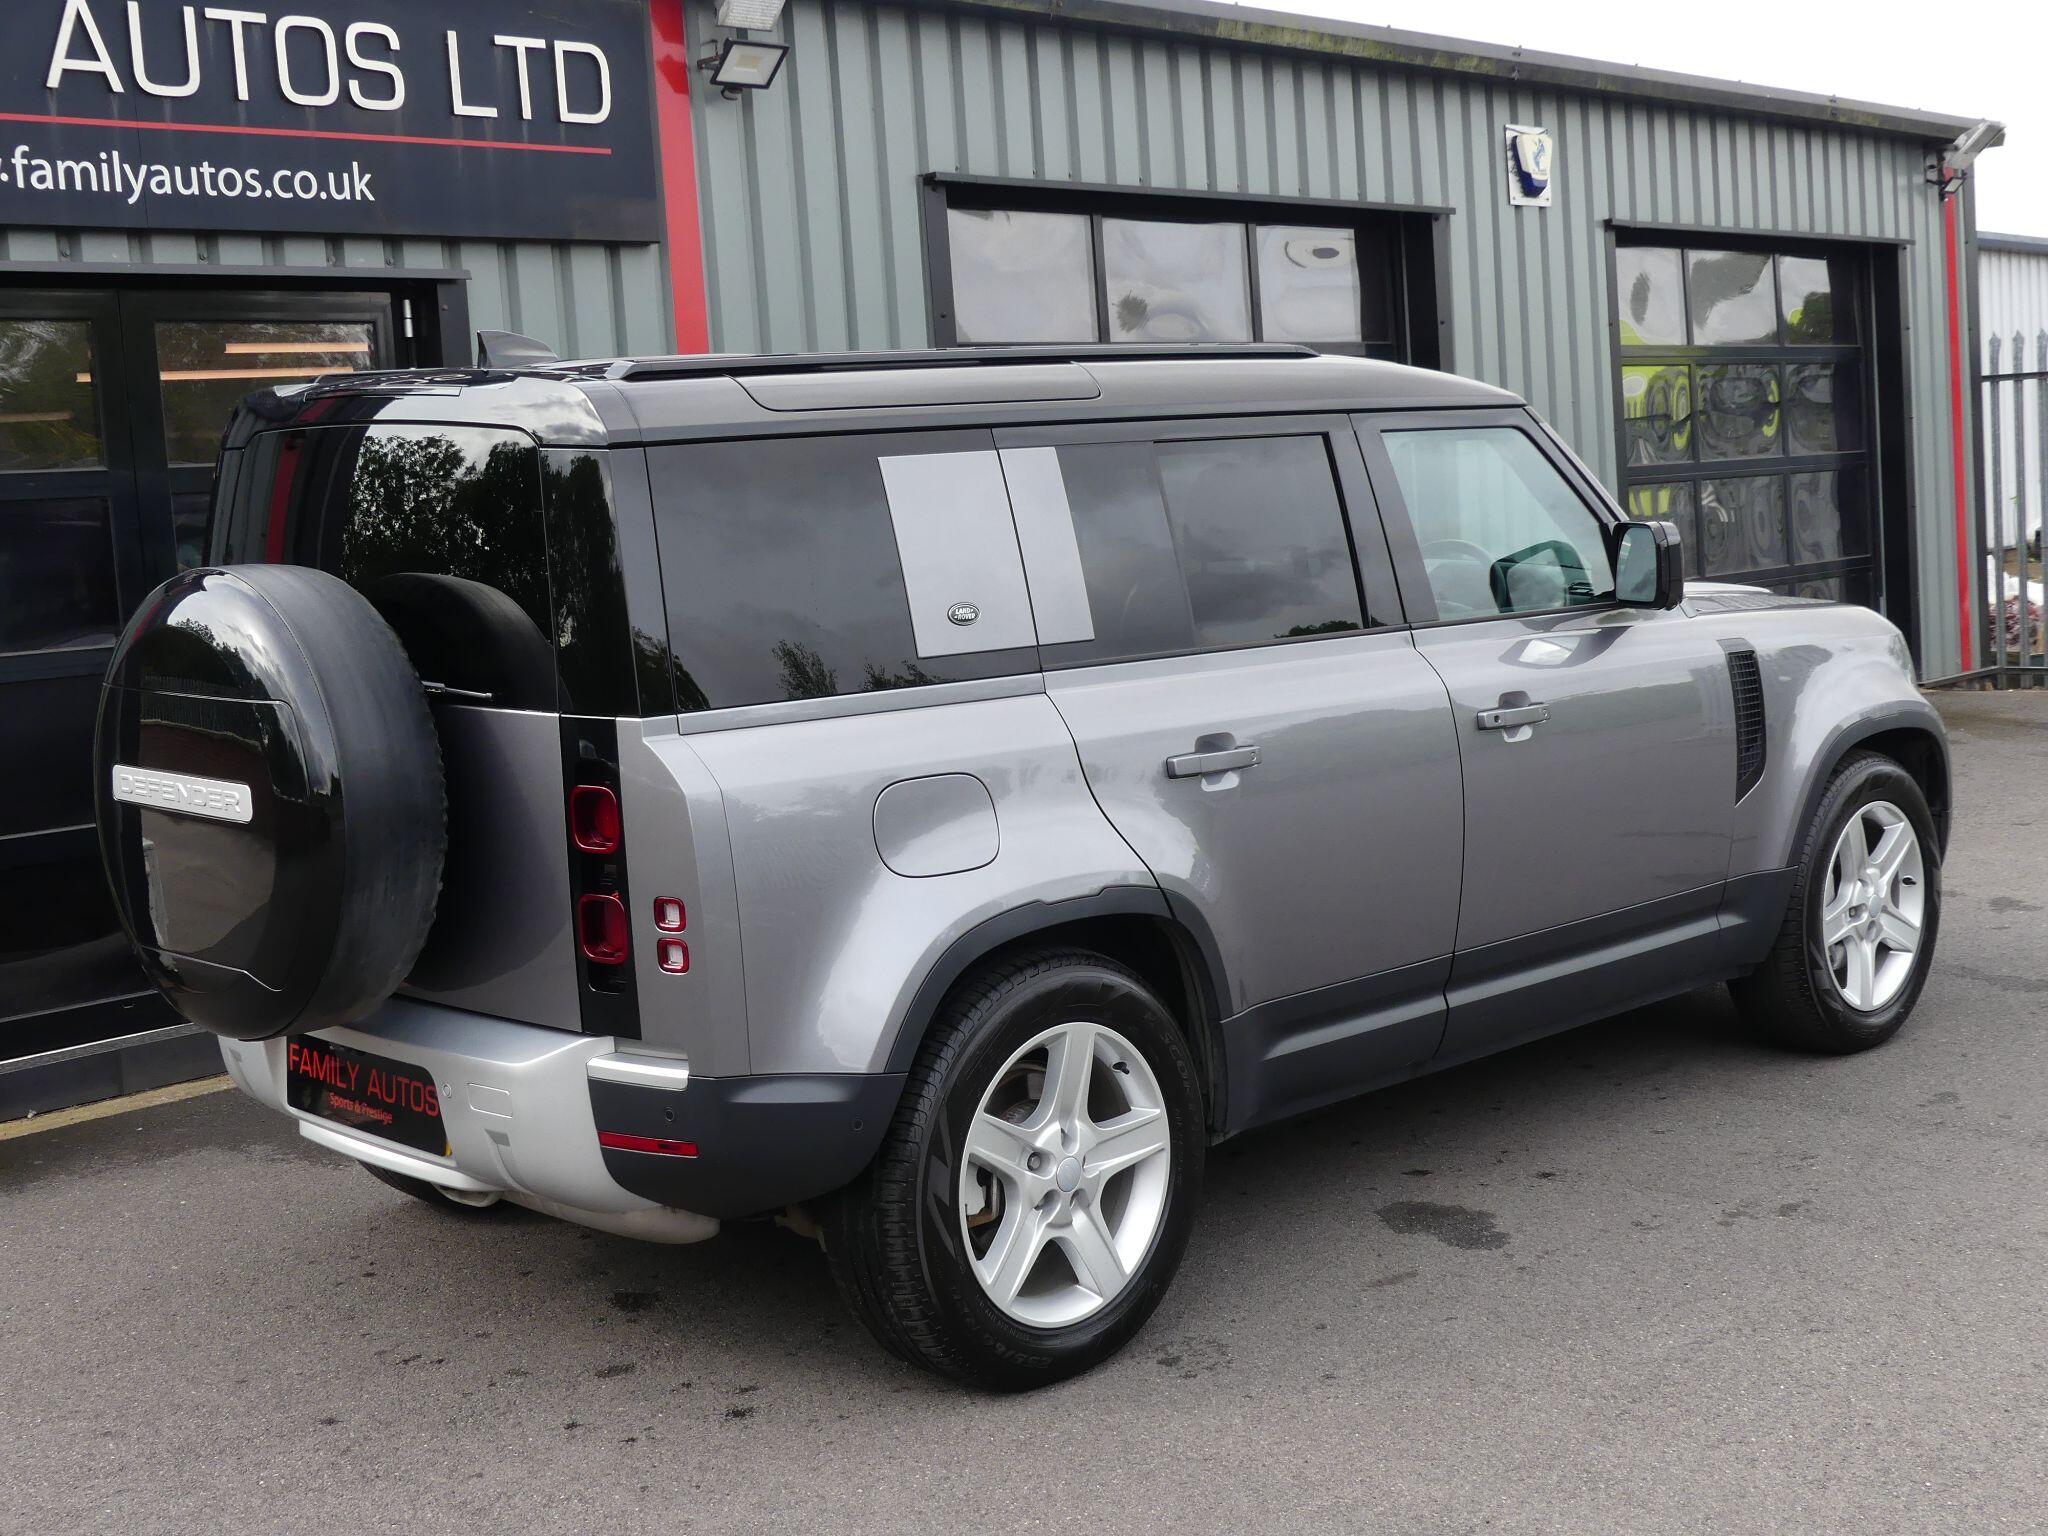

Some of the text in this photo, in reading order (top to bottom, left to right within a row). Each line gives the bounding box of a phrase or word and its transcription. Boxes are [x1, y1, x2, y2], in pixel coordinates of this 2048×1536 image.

[46, 0, 612, 125] AUTOS LTD
[0, 144, 376, 205] .familyautos.co.uk
[955, 607, 971, 615] LAND
[957, 611, 976, 620] ROVER
[119, 773, 241, 813] DEFENDER
[289, 1043, 440, 1117] FAMILY AUTOS
[329, 1091, 354, 1110] Sports
